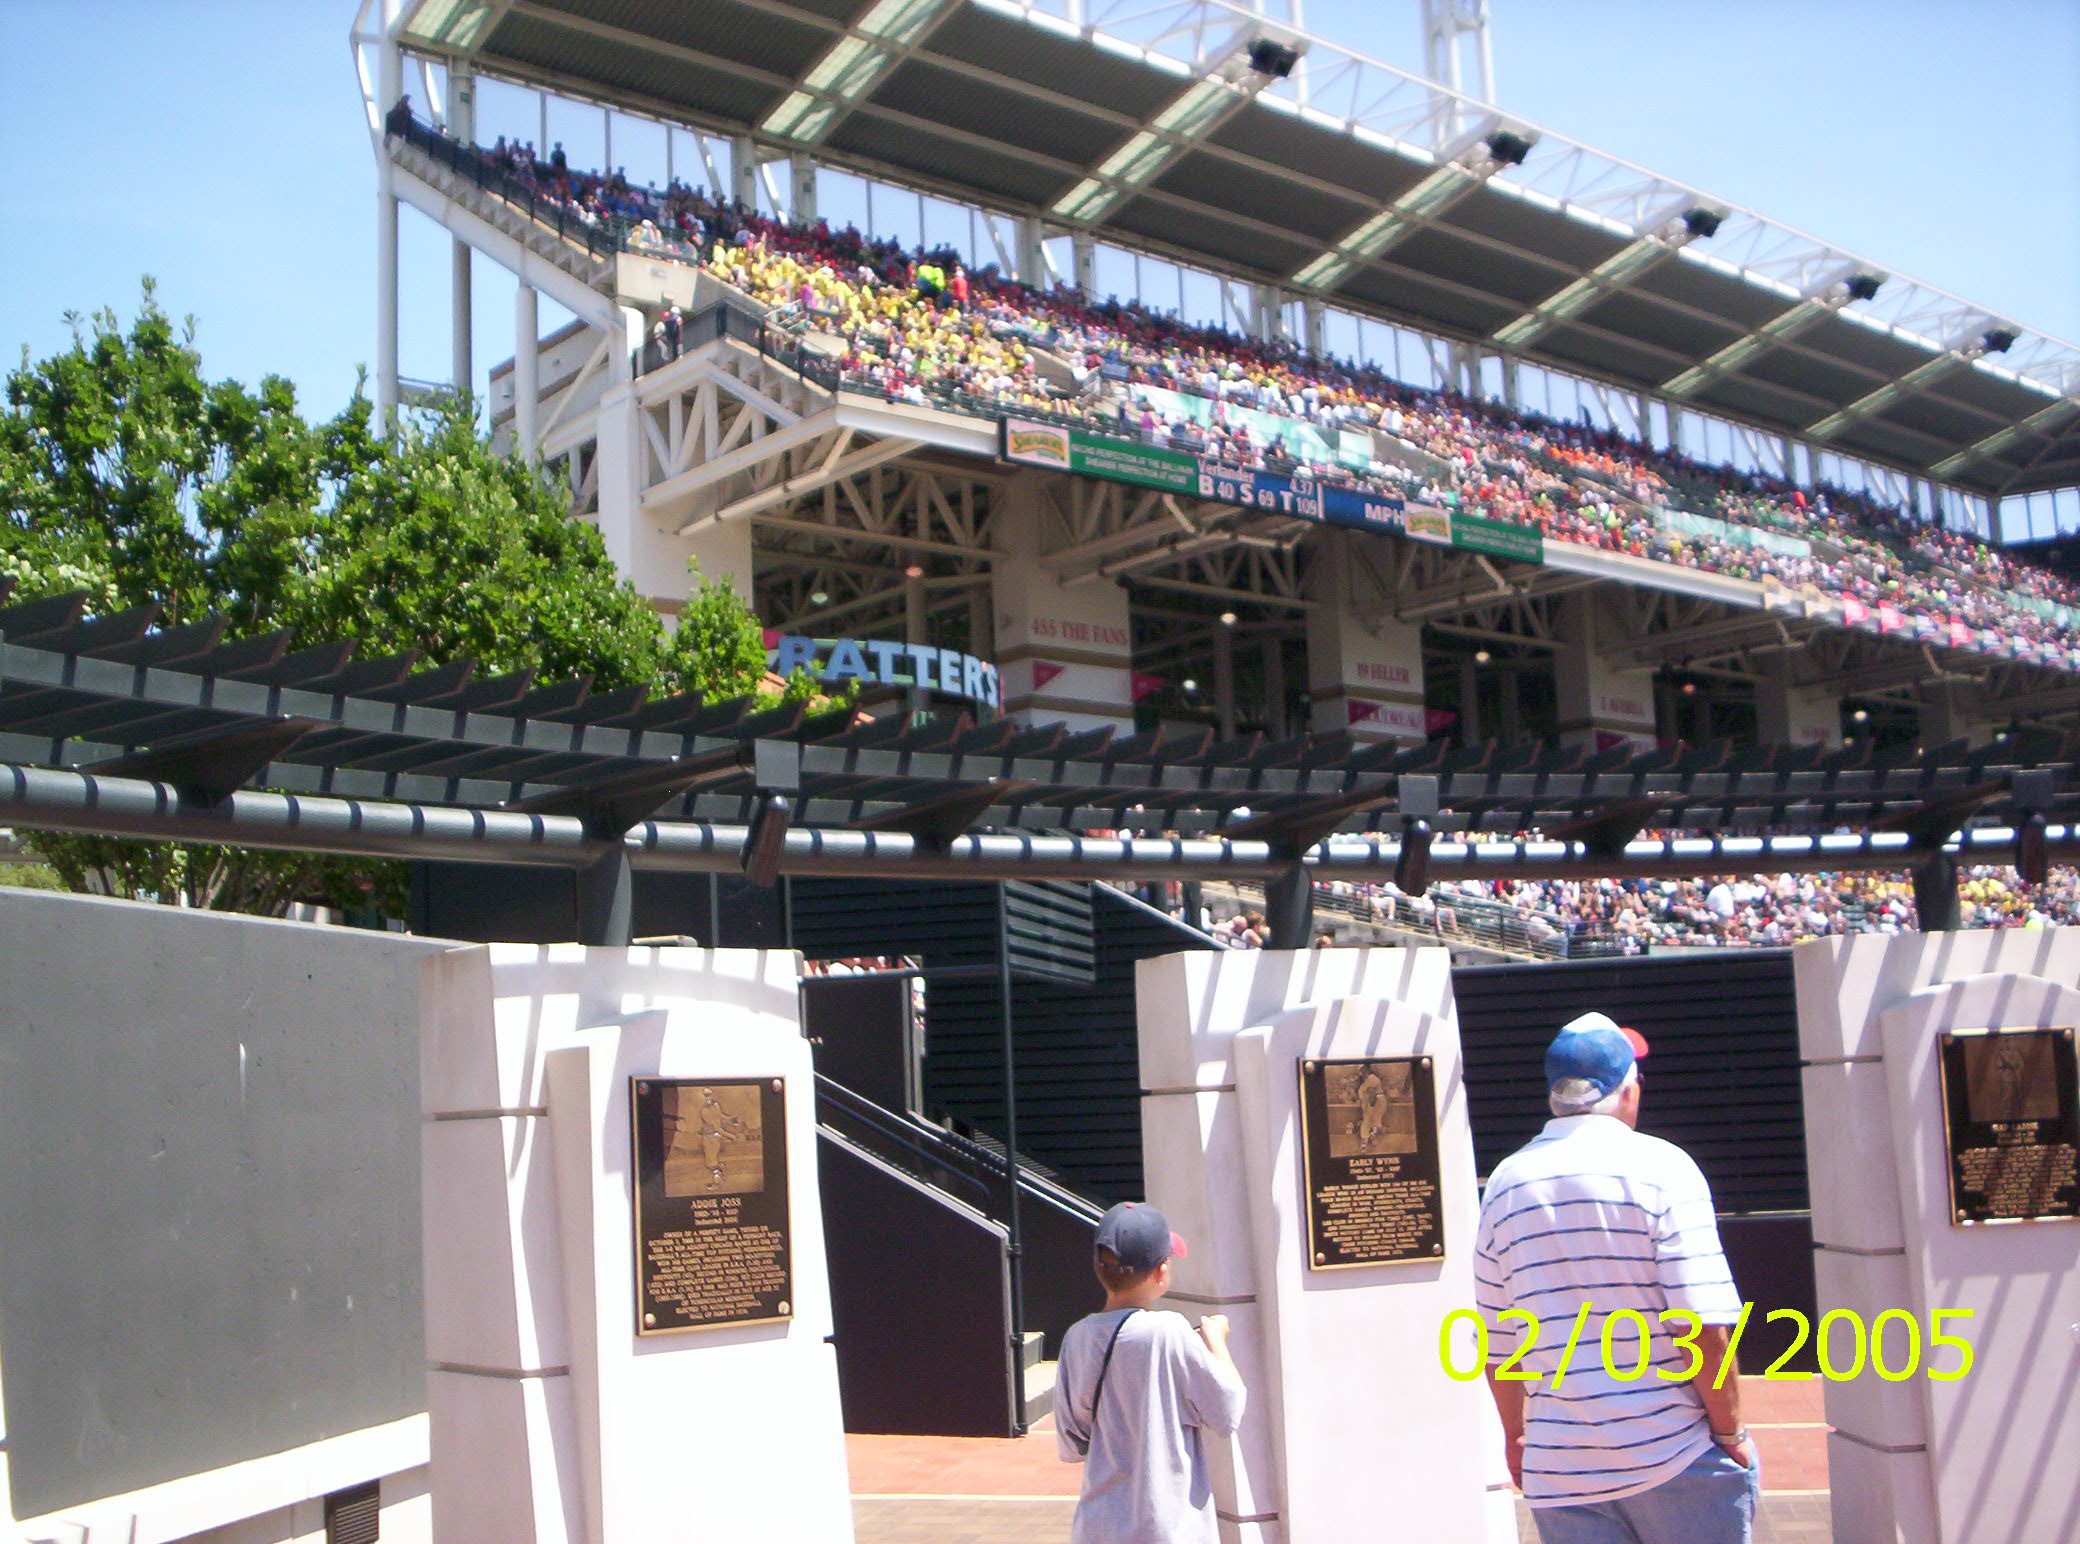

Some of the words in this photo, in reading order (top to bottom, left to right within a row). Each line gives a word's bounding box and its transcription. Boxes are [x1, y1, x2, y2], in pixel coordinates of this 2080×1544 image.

[1197, 459, 1255, 484] Verlander
[1199, 475, 1215, 497] B
[1217, 481, 1235, 499] 40
[1240, 483, 1254, 504] S
[1258, 489, 1275, 508] 69
[1280, 490, 1293, 512] T
[1295, 496, 1318, 516] 109
[1364, 502, 1406, 526] MPH
[1061, 621, 1089, 641] THE
[1092, 625, 1129, 646] FANS
